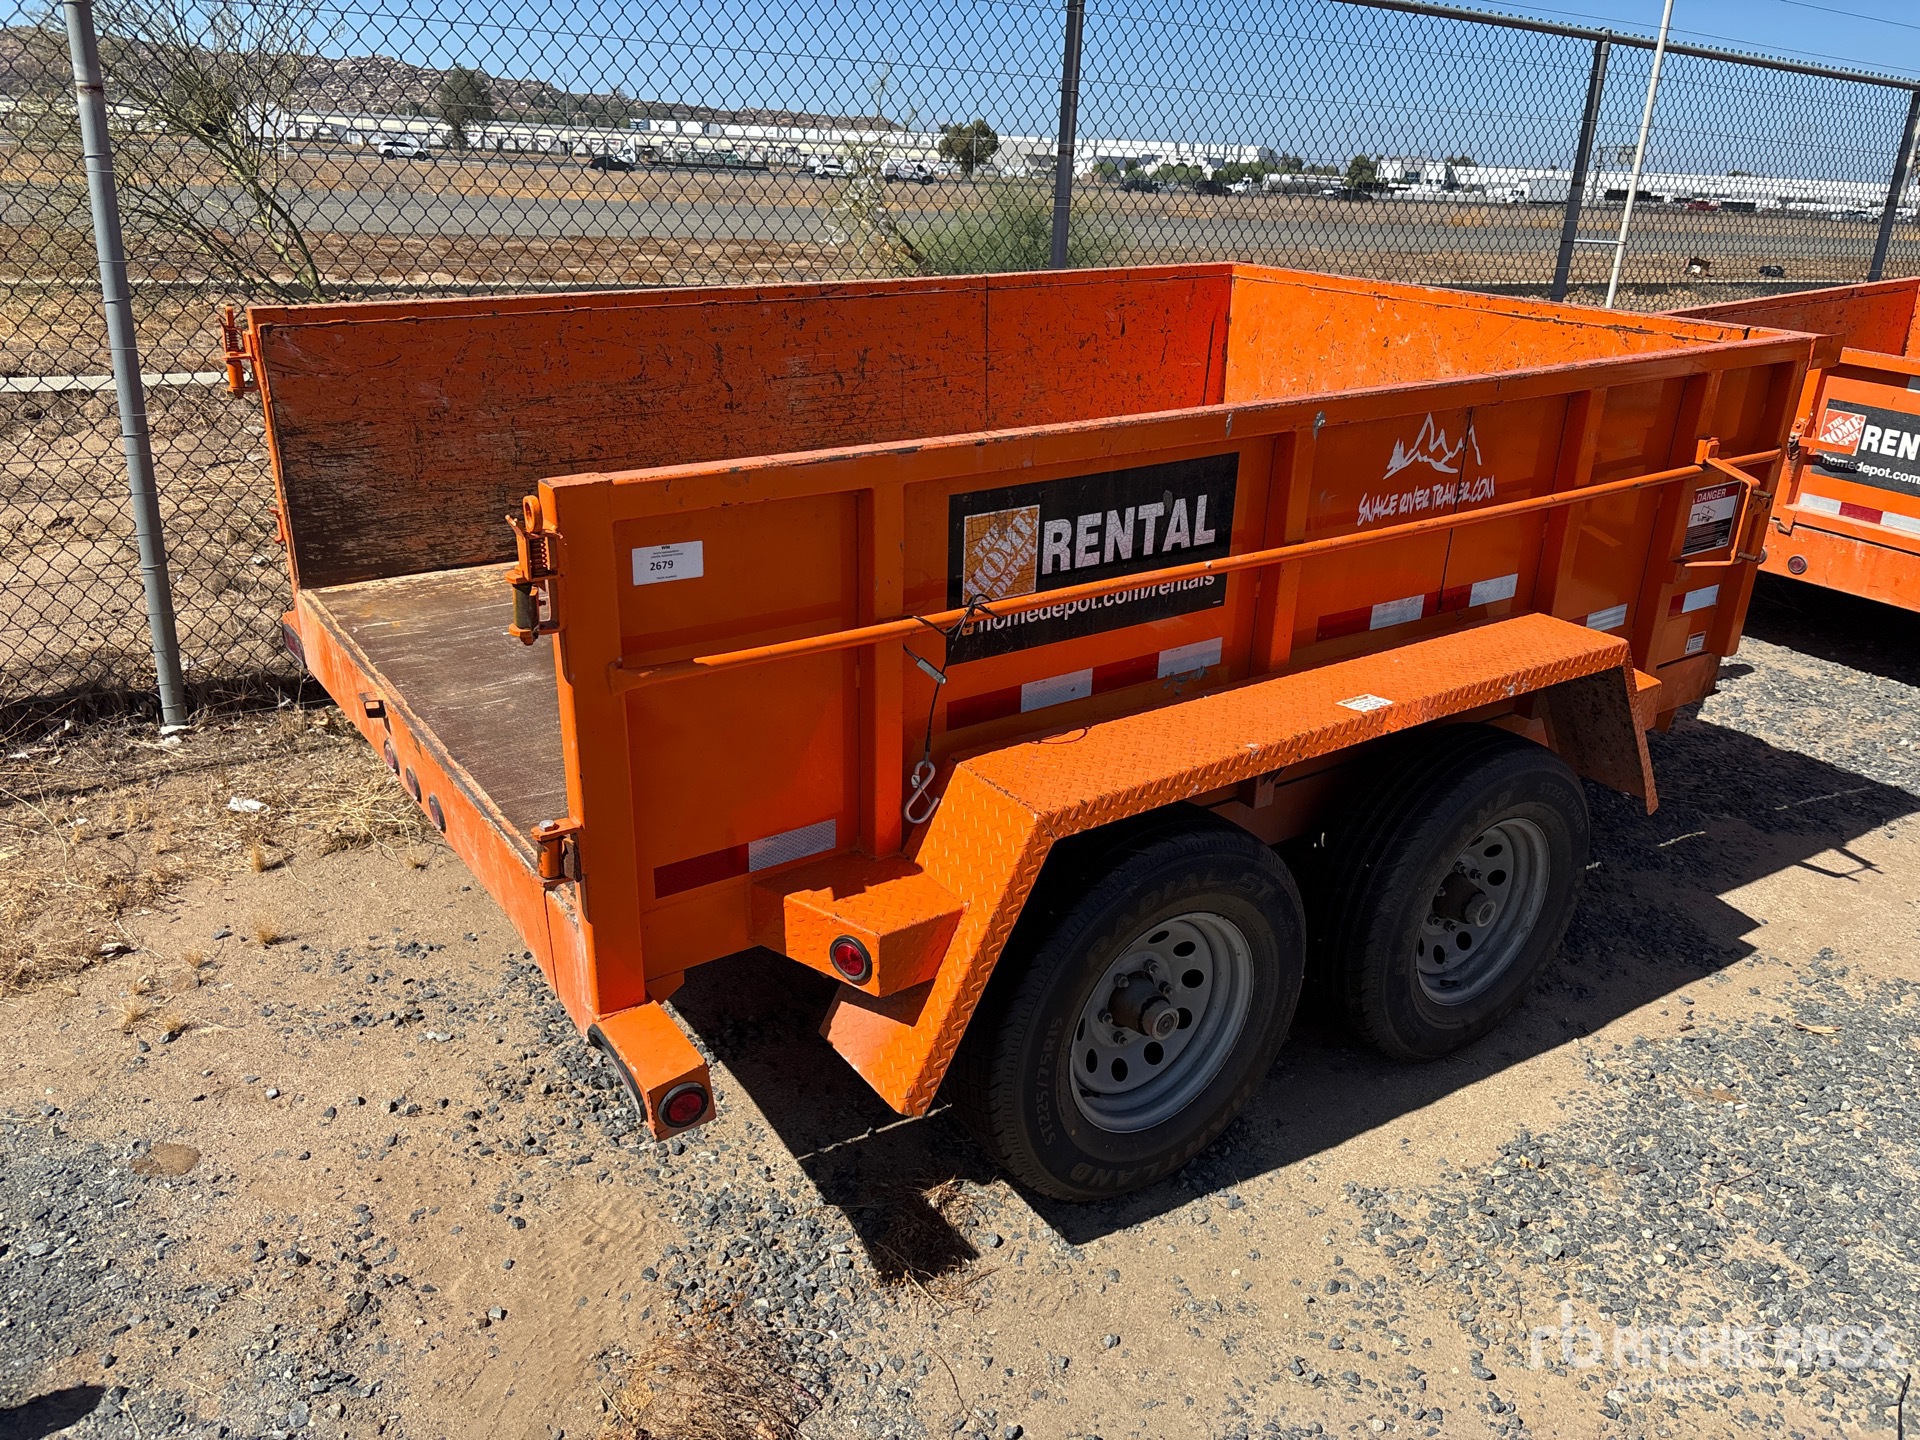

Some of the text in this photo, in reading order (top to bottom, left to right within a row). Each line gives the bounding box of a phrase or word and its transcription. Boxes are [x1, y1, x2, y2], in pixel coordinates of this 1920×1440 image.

[1827, 415, 1846, 430] THE
[1357, 492, 1399, 526] SNAKE
[1398, 485, 1430, 514] RIVER
[1696, 488, 1727, 503] DANGER
[966, 510, 1039, 600] HOME
[972, 523, 1000, 558] THE
[1041, 495, 1216, 575] RENTAL
[649, 560, 674, 571] 2679
[992, 540, 1037, 597] DEPOT
[1036, 1016, 1063, 1146] ST225/75R15
